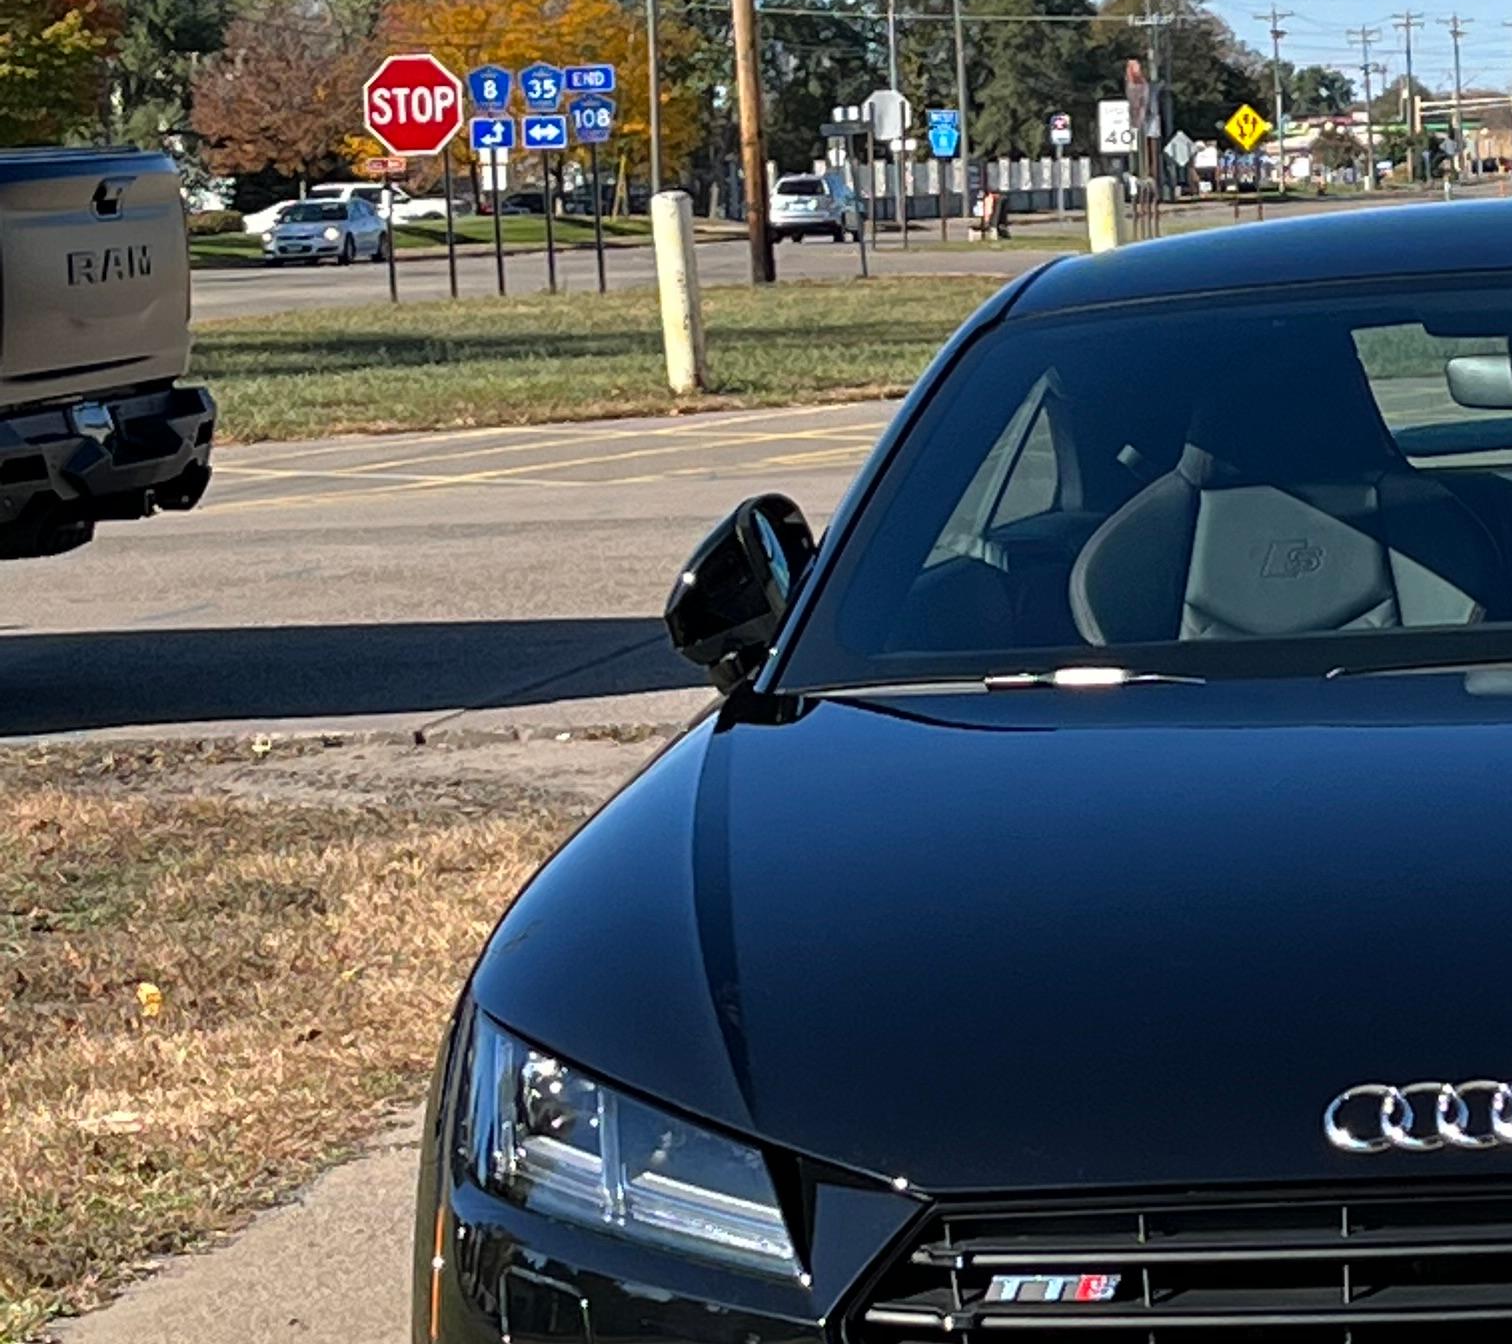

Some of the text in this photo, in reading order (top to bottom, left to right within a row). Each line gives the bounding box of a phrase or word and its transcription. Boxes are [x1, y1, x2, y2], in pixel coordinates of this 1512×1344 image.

[483, 79, 498, 100] 8
[527, 78, 558, 100] 35
[571, 70, 605, 88] END
[371, 85, 455, 126] STOP
[573, 106, 611, 129] 108
[1104, 129, 1136, 145] 40
[66, 244, 152, 287] RAM
